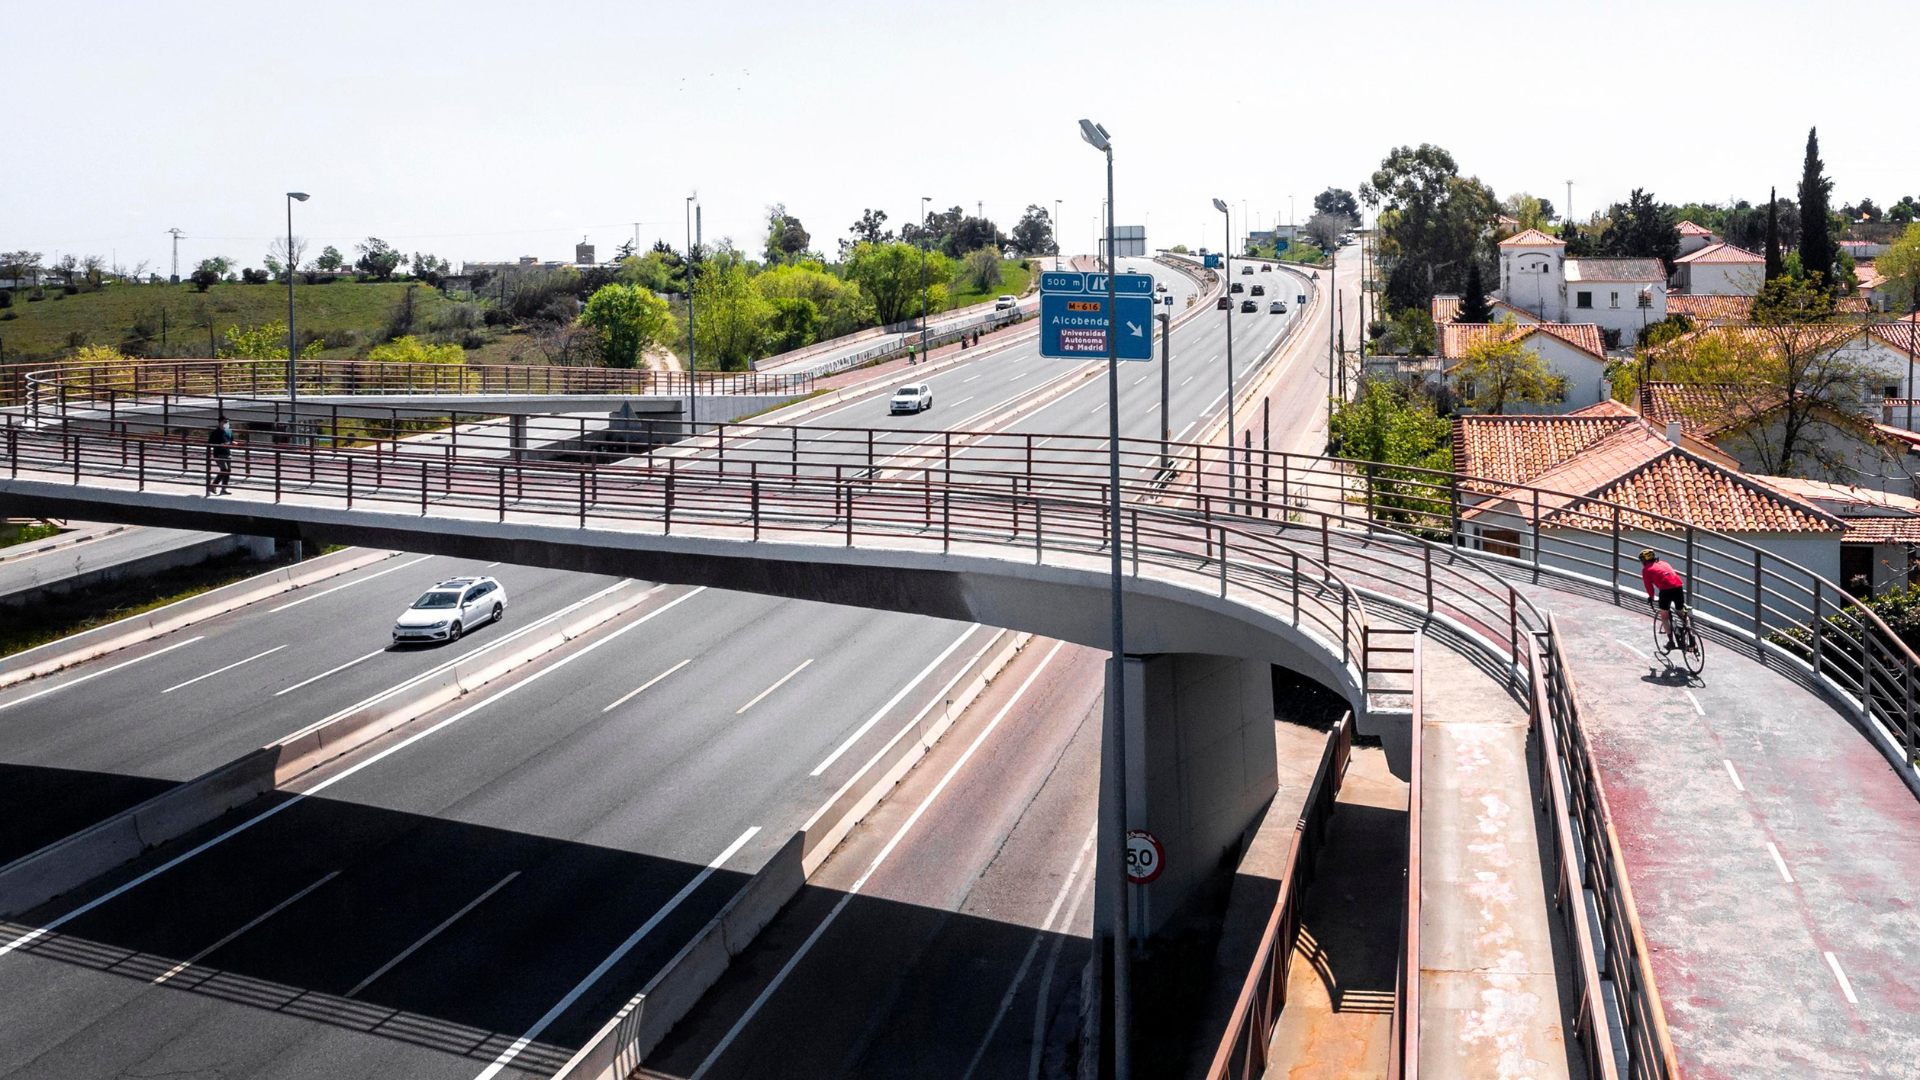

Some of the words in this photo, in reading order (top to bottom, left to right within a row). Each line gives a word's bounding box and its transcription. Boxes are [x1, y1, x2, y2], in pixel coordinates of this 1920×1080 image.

[1047, 278, 1066, 286] 500
[1068, 302, 1099, 311] M-616
[1052, 316, 1109, 326] Alcobenda
[1127, 848, 1153, 866] 50
